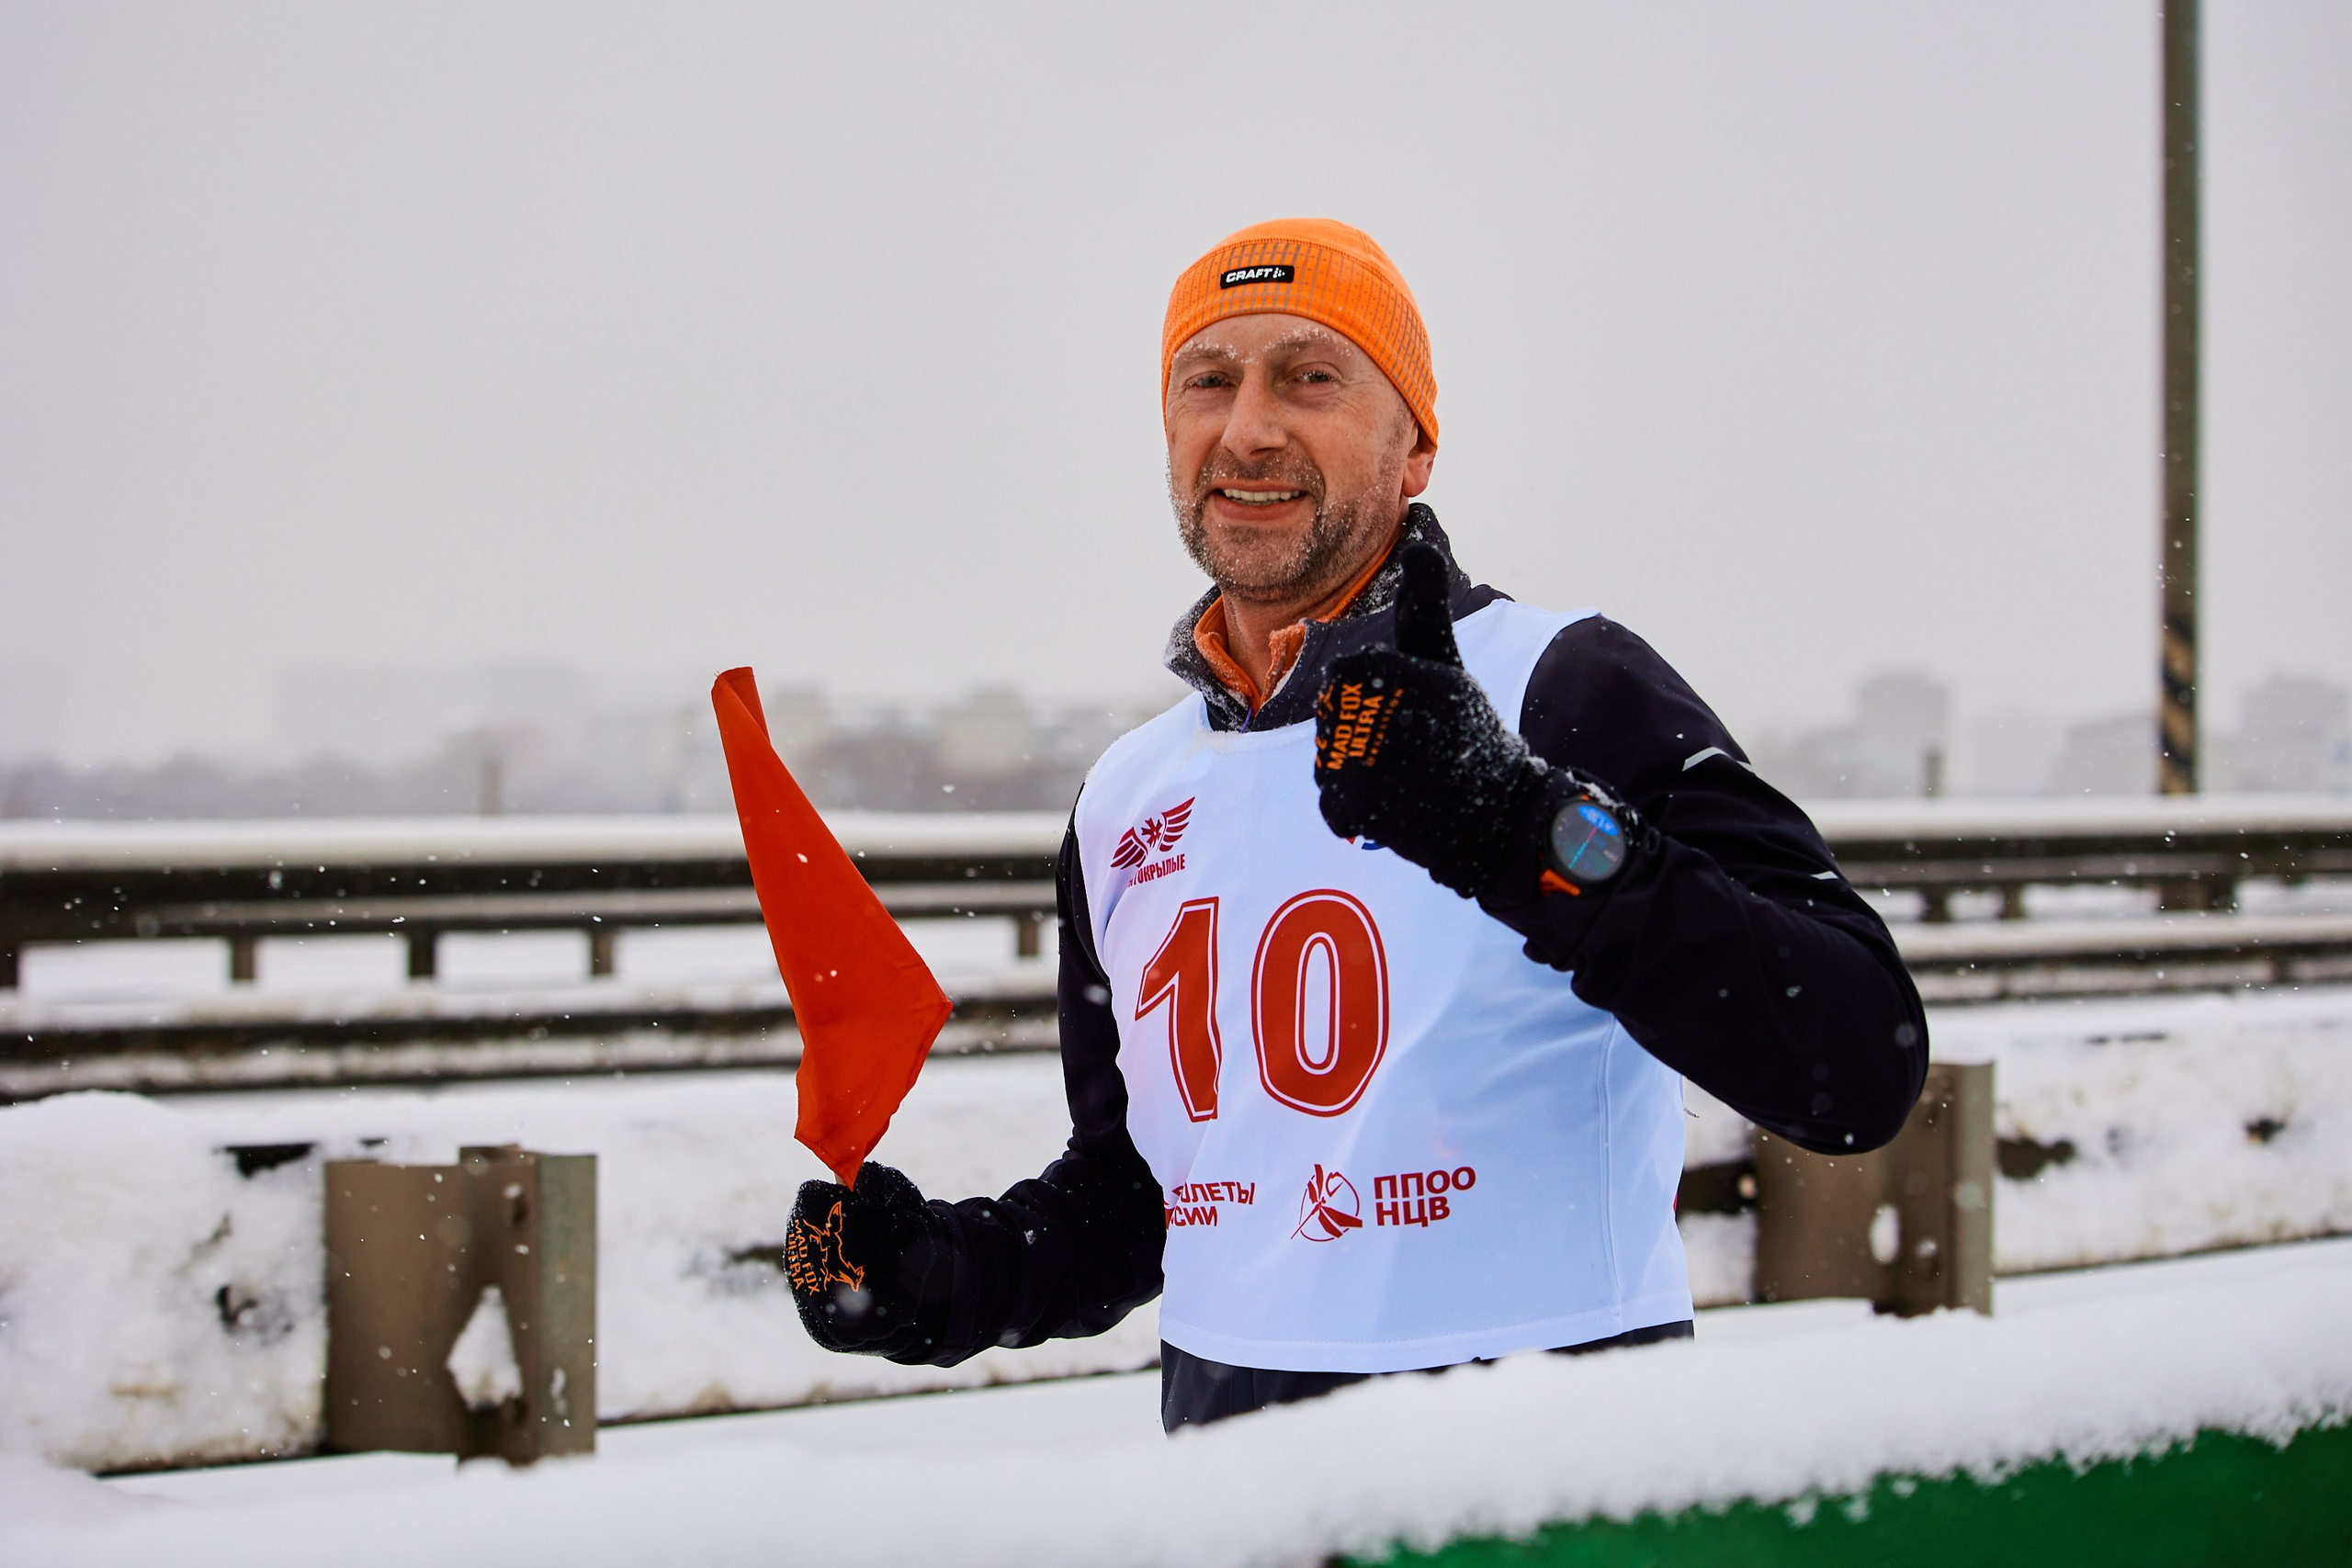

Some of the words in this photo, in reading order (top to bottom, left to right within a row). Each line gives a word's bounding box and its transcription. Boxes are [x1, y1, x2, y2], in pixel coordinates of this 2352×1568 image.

[1226, 267, 1273, 283] CRAFT
[1339, 682, 1363, 721] FOX
[1326, 724, 1353, 771] MAD
[1347, 694, 1385, 758] ULTRA
[1135, 888, 1390, 1122] 10
[1374, 1166, 1476, 1200] ППОО
[1375, 1196, 1451, 1228] НЦВ
[787, 1233, 804, 1291] ULTRA
[795, 1219, 808, 1258] MAD
[802, 1262, 820, 1296] FOX
